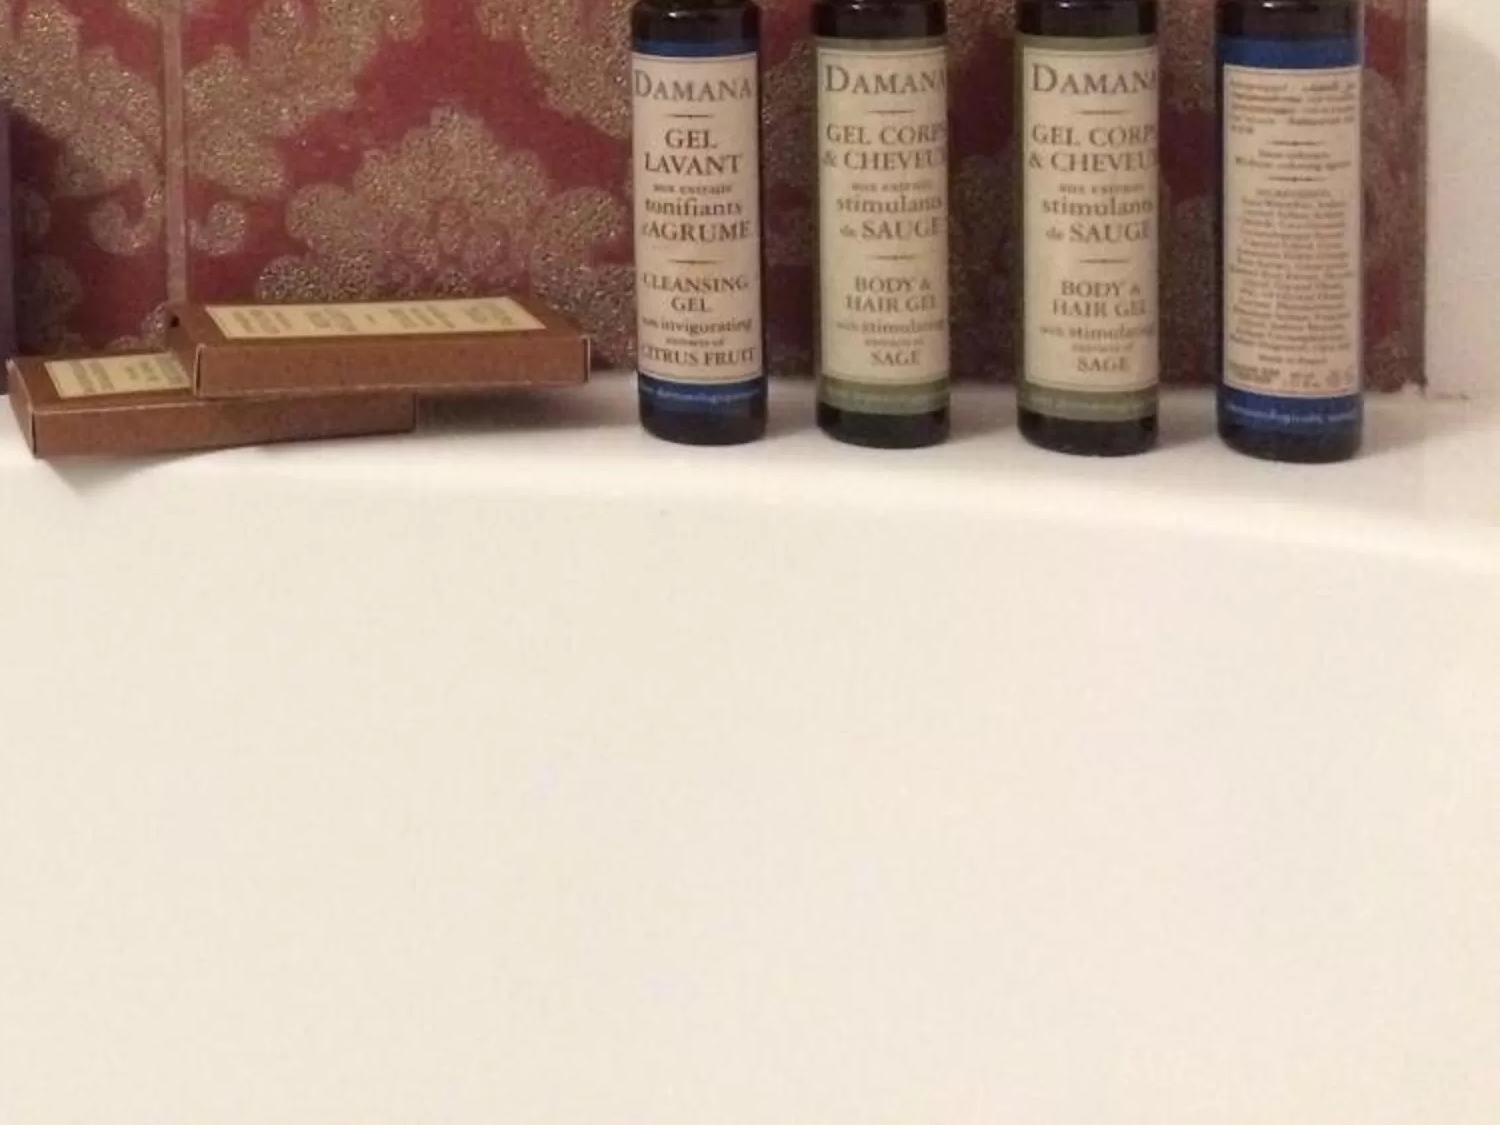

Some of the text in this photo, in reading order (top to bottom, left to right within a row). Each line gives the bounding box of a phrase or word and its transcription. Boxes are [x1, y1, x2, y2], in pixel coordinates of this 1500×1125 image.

[634, 69, 751, 103] DAMANA
[664, 128, 718, 150] GEL
[827, 124, 872, 145] GEL
[1032, 124, 1081, 146] GEL
[644, 151, 744, 176] LAVANT
[821, 150, 837, 168] &
[861, 216, 945, 241] SAUGE
[1069, 218, 1149, 243] SAUGE
[643, 273, 749, 293] CLEANSING
[855, 276, 913, 294] BODY
[1061, 279, 1125, 298] BODY
[670, 297, 714, 313] GEL
[845, 293, 937, 313] HAIR GEL
[1053, 298, 1109, 318] HAIR
[870, 349, 920, 368] SAGE
[1077, 356, 1128, 373] SAGE
